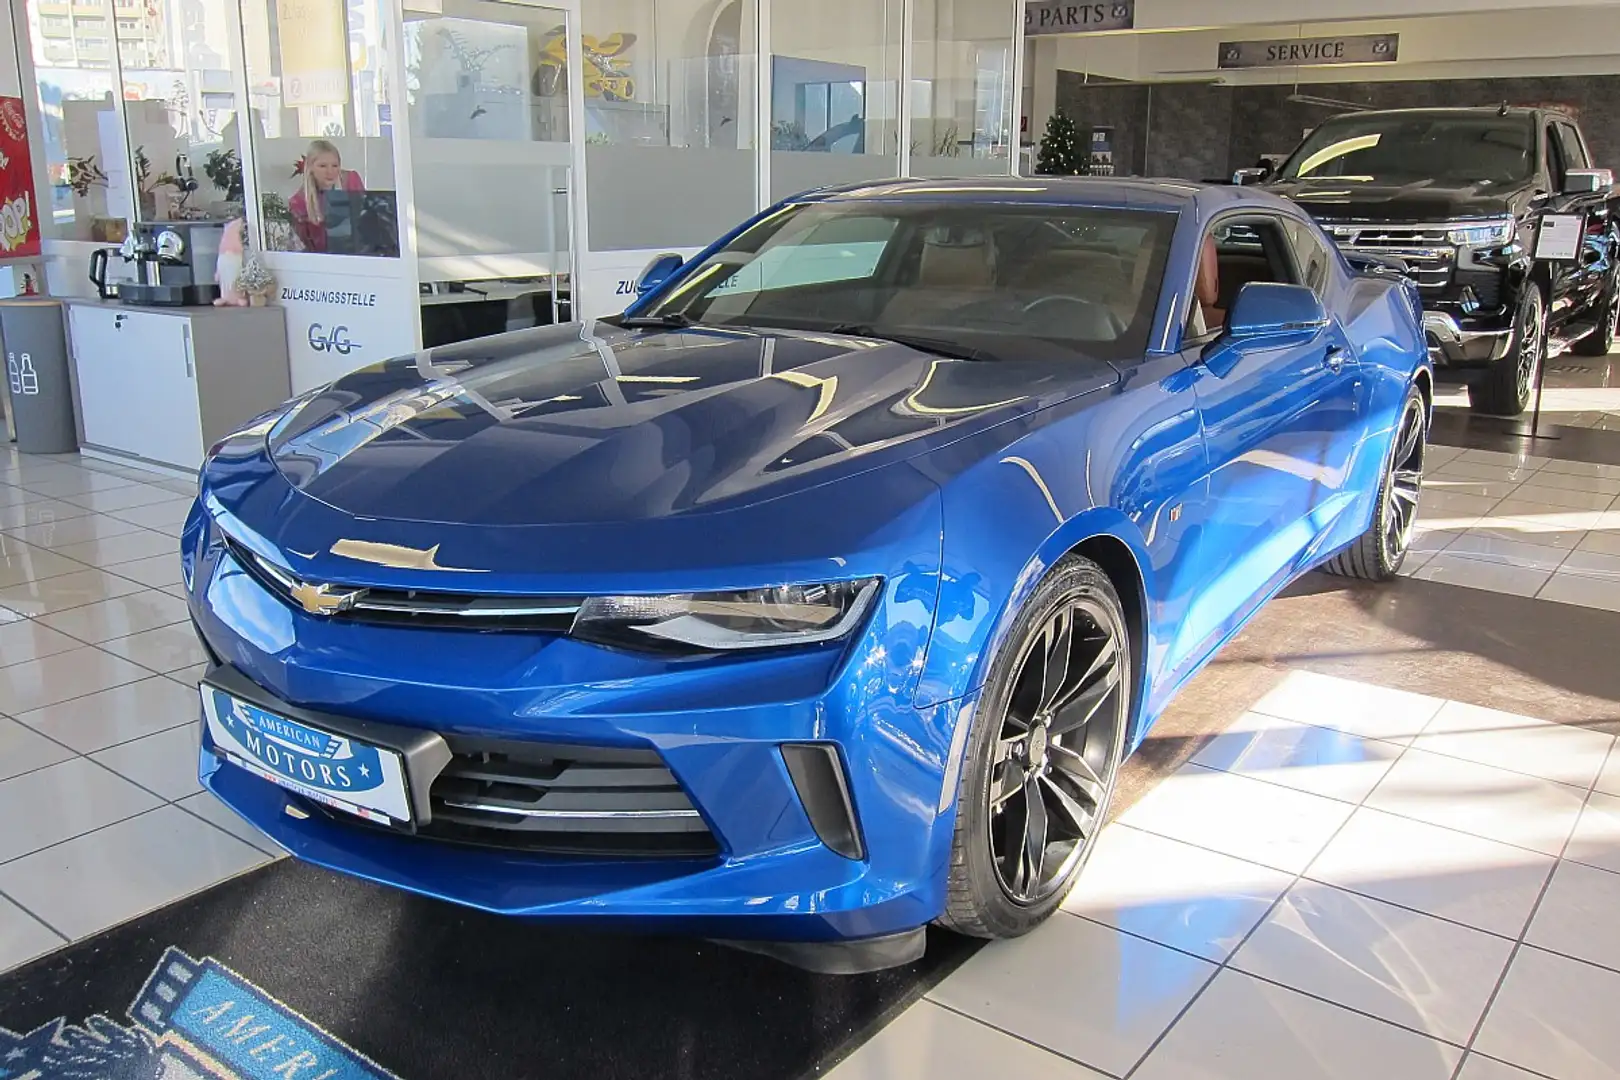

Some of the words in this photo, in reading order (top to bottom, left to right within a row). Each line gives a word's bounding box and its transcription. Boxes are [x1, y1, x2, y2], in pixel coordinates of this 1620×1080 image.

[1039, 3, 1105, 27] PARTS
[1266, 42, 1345, 61] SERVICE
[281, 287, 376, 307] ZULASSUNGSSTELLE
[258, 715, 321, 749] AMERICAN
[246, 730, 352, 787] MOTORS
